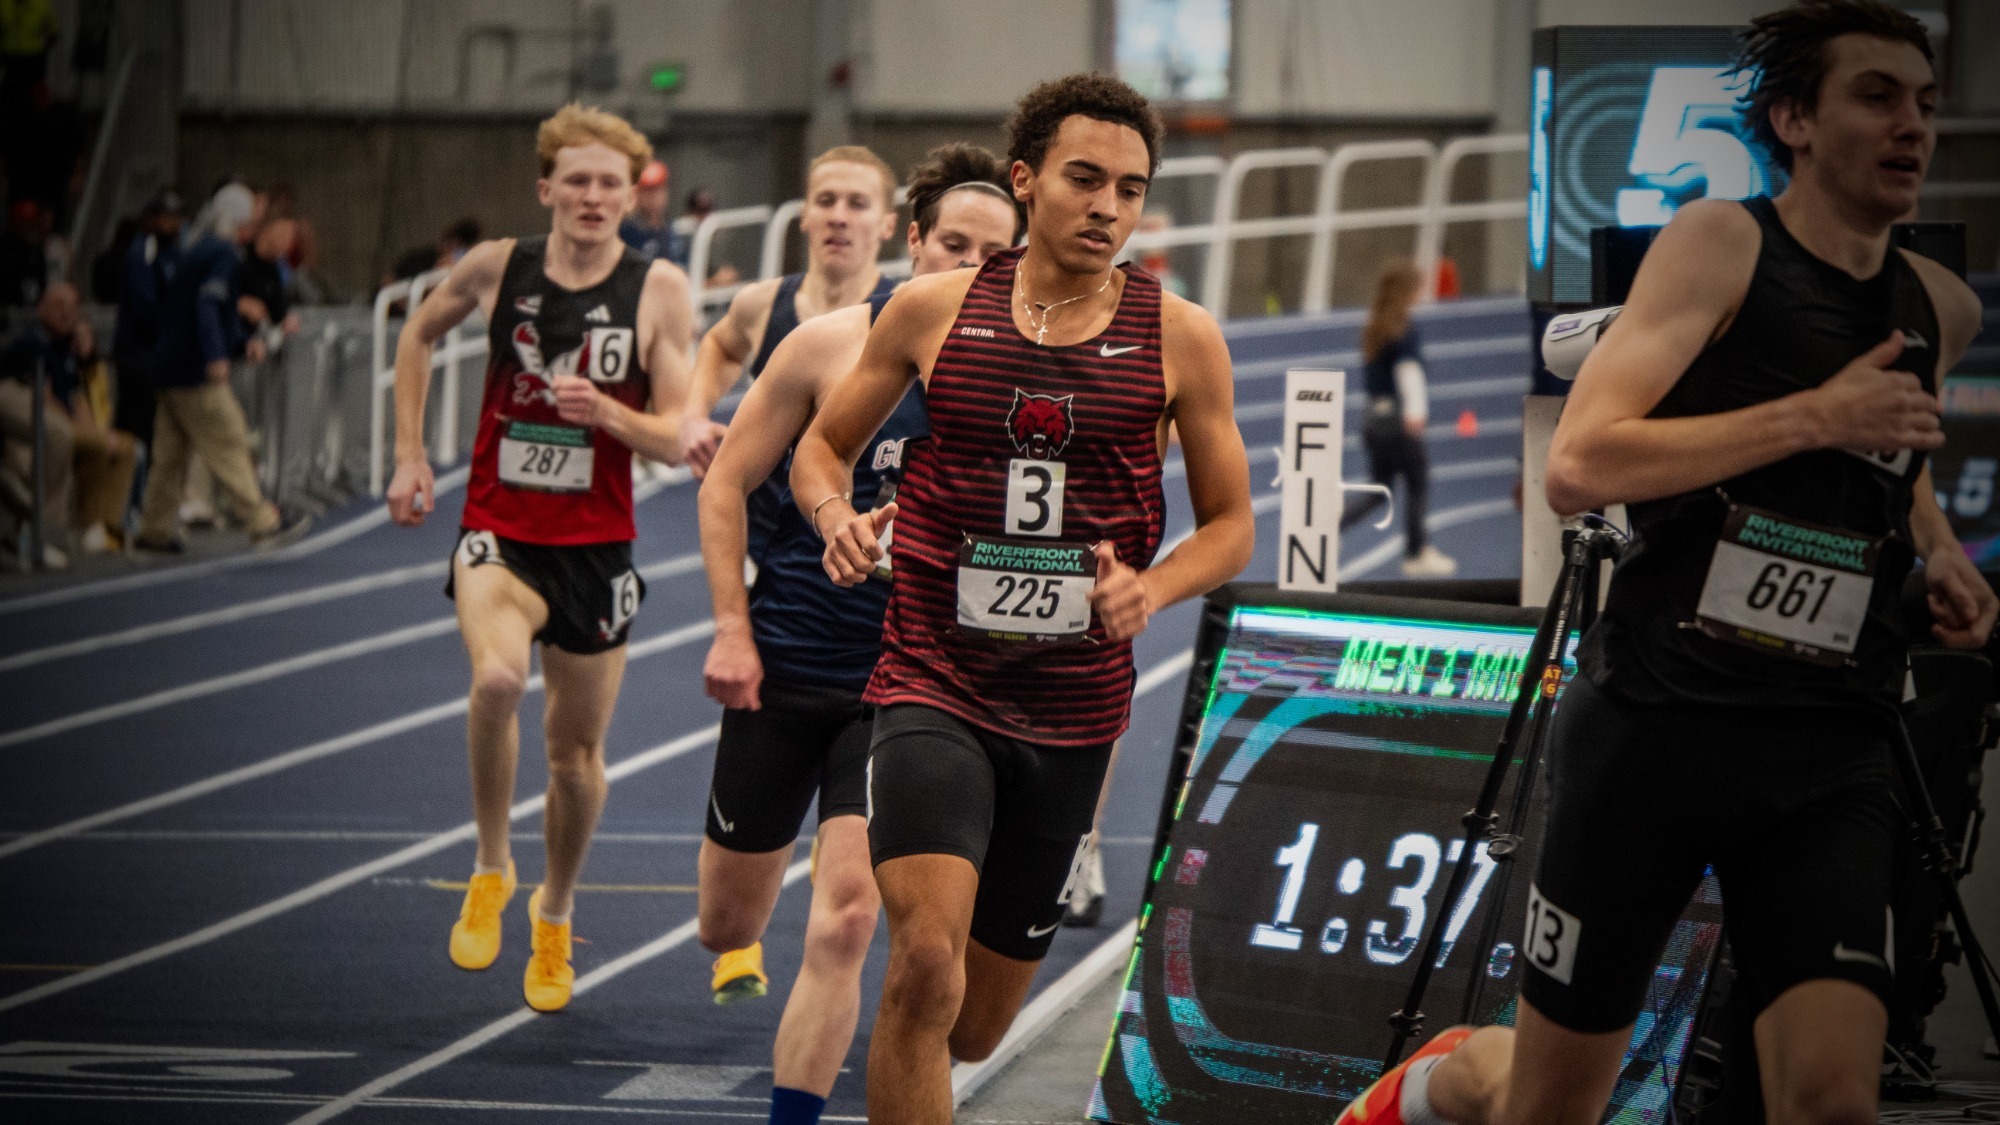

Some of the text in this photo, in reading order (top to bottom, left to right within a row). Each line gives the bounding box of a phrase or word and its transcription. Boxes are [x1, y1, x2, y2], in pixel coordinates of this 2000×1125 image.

[1617, 67, 1768, 228] 5
[961, 327, 995, 338] CENTRAL
[600, 332, 622, 377] 6
[1296, 390, 1334, 402] GILL
[520, 445, 571, 476] 287
[1018, 466, 1052, 532] 3
[975, 542, 1083, 561] RIVERFRONT
[1737, 528, 1867, 571] INVITATIONAL
[1745, 513, 1870, 553] RIVERFRONT
[971, 553, 1085, 573] INVITATIONAL
[621, 576, 634, 617] 6
[988, 575, 1063, 619] 225
[1747, 562, 1836, 624] 661
[1334, 636, 1431, 694] MEN
[1543, 669, 1561, 680] AT
[1546, 683, 1555, 694] 6
[1528, 900, 1563, 968] 13
